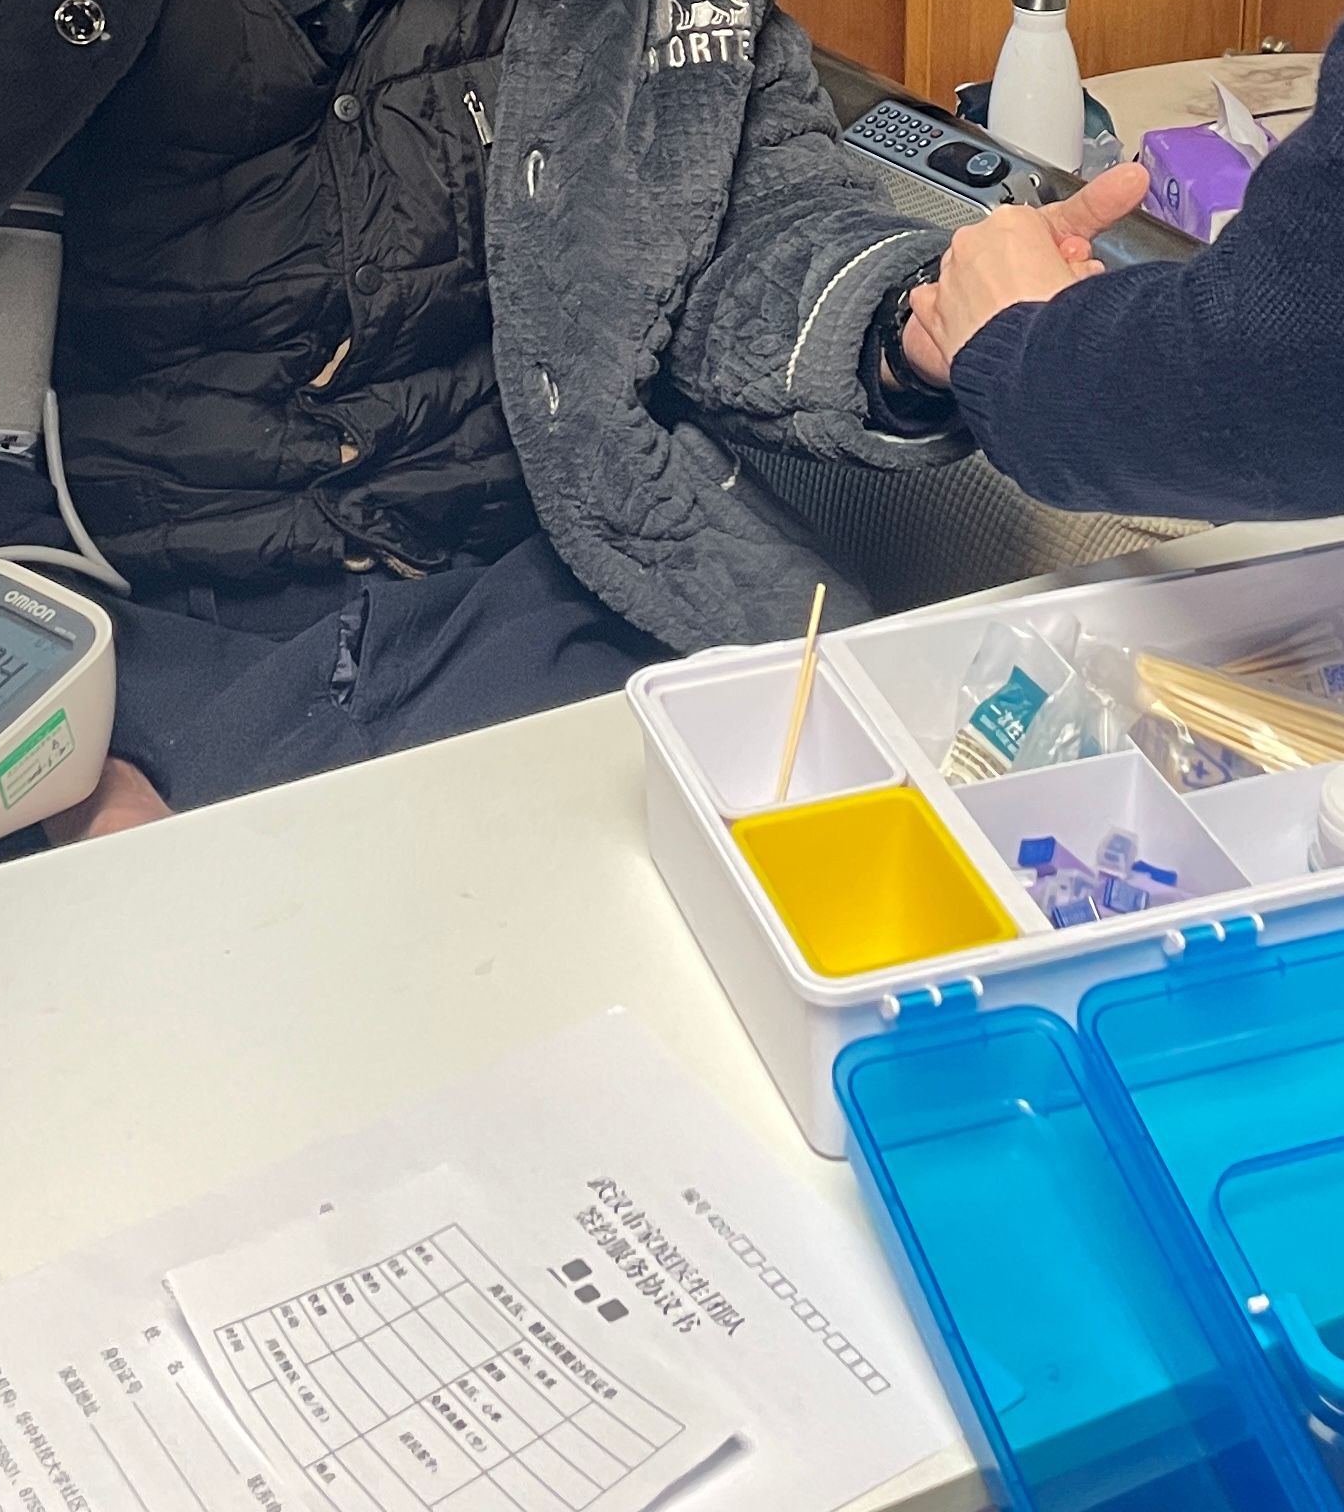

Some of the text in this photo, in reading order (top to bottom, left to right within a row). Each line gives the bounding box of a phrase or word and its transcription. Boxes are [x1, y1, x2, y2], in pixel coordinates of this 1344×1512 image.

[4, 590, 56, 622] OMRON
[576, 1205, 701, 1333] 签约服务协议书
[587, 1177, 745, 1336] 武汉市家庭医生团队
